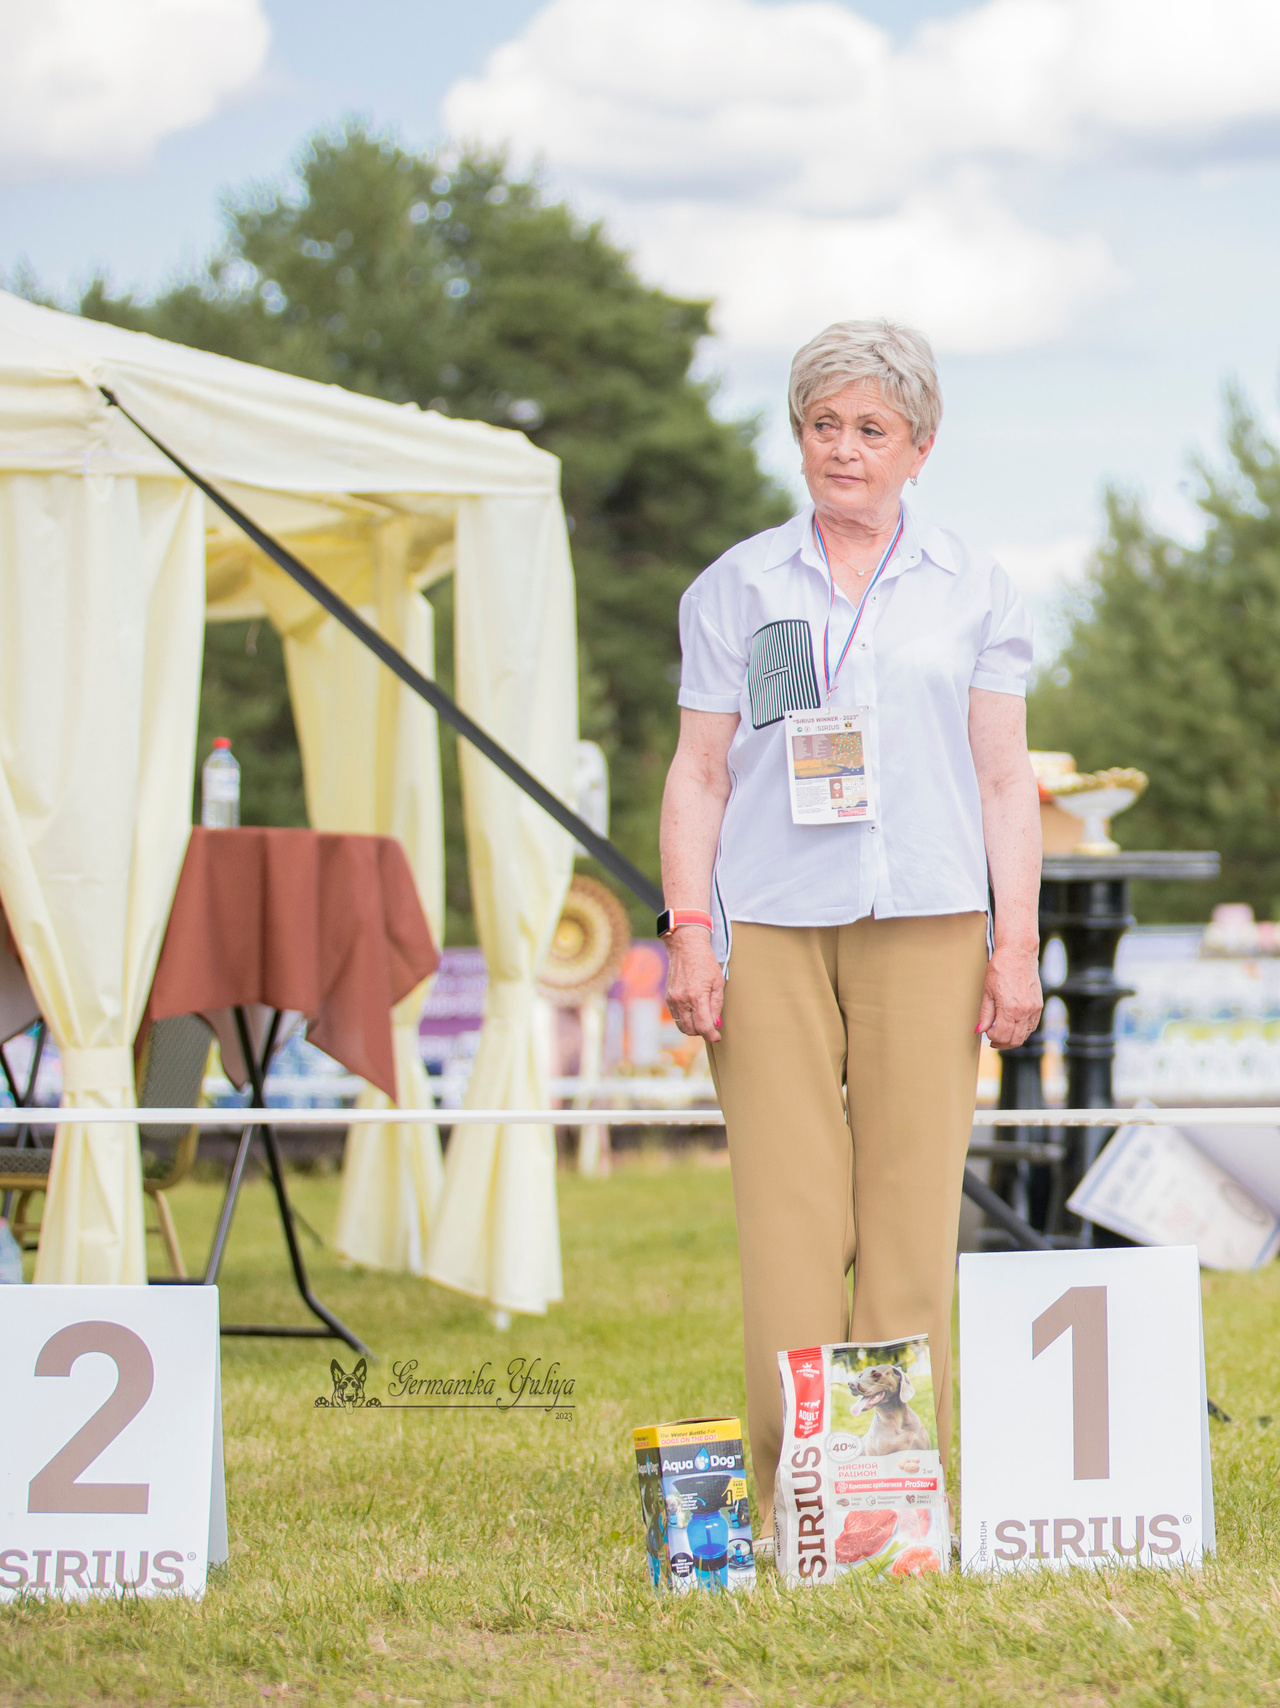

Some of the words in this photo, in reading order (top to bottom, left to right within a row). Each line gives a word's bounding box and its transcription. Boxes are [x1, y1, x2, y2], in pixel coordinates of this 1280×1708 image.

[1032, 1286, 1109, 1480] 1
[27, 1320, 154, 1514] 2
[798, 1409, 820, 1421] ADULT
[661, 1437, 679, 1445] DOGS
[833, 1443, 856, 1452] 40%
[661, 1459, 694, 1473] Aqua
[838, 1462, 878, 1471] МЯСНОЙ
[904, 1480, 934, 1488] ProStor+
